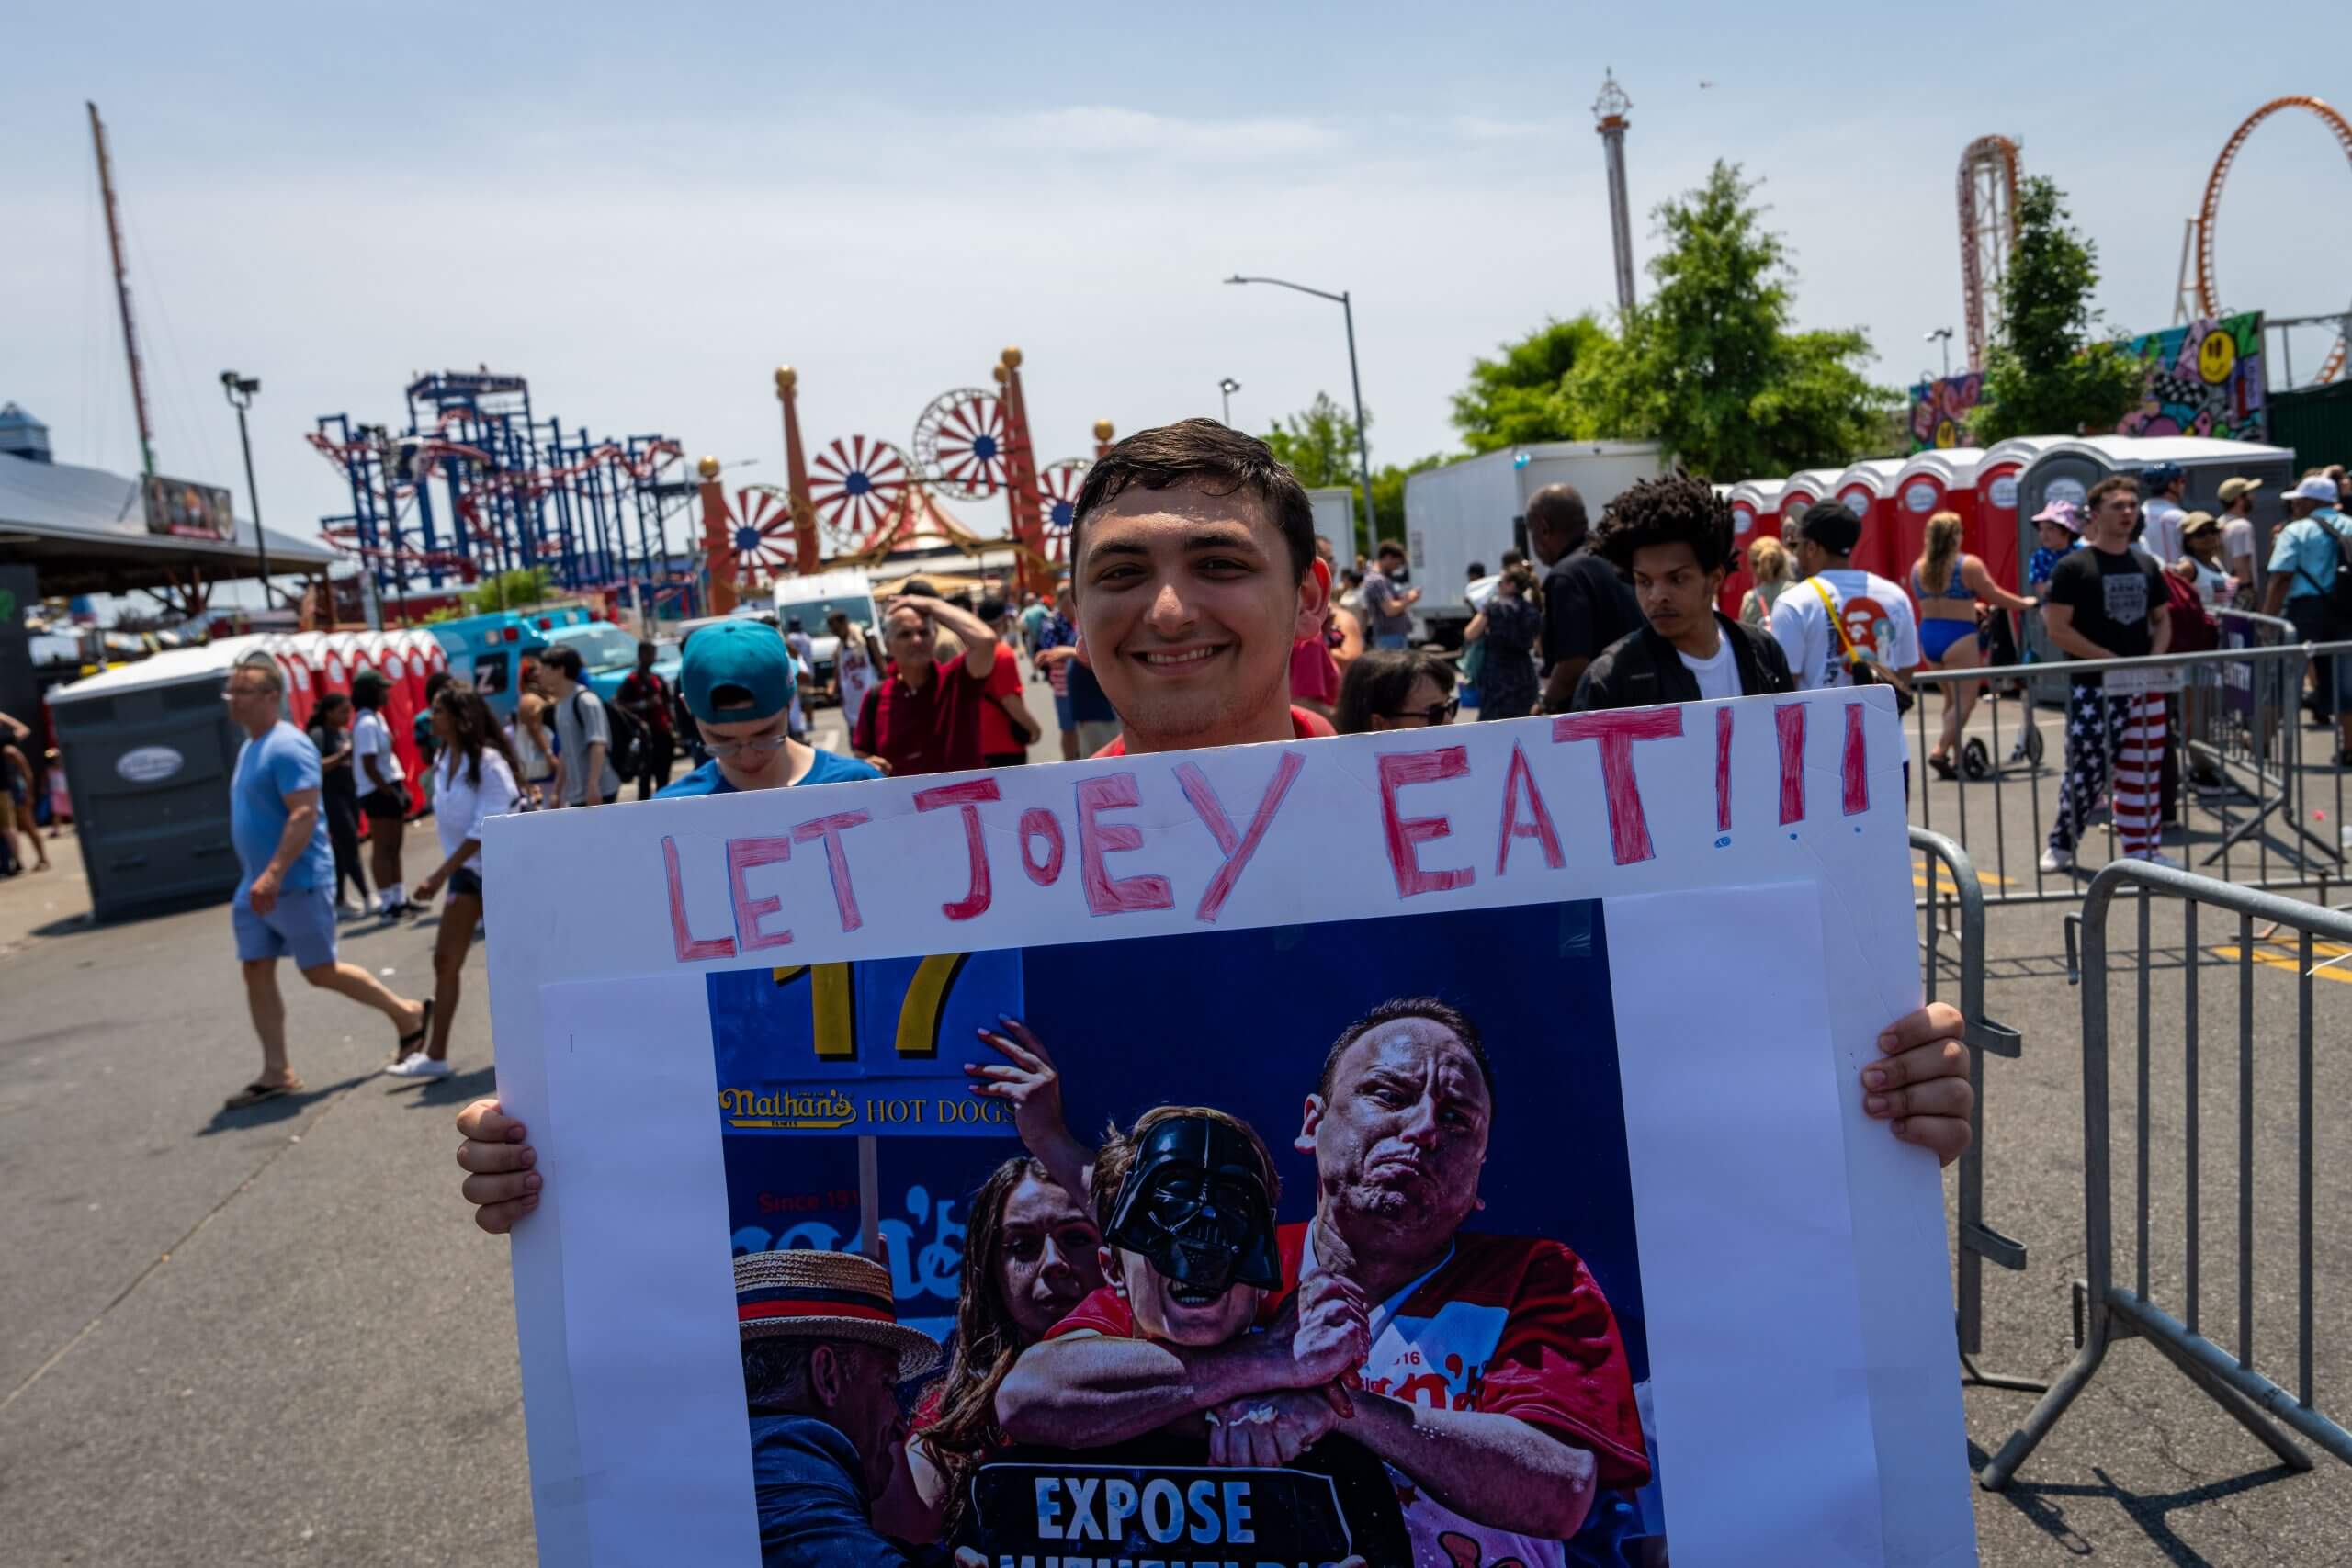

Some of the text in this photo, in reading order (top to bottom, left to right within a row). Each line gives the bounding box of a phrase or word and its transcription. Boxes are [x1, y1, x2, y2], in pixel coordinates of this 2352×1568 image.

[662, 808, 873, 963] LET
[1375, 702, 1870, 900] EAT!!!
[719, 1087, 857, 1121] Nathan's
[867, 1100, 927, 1123] HOT
[757, 1190, 860, 1213] Since 191
[1035, 1477, 1256, 1544] EXPOSE
